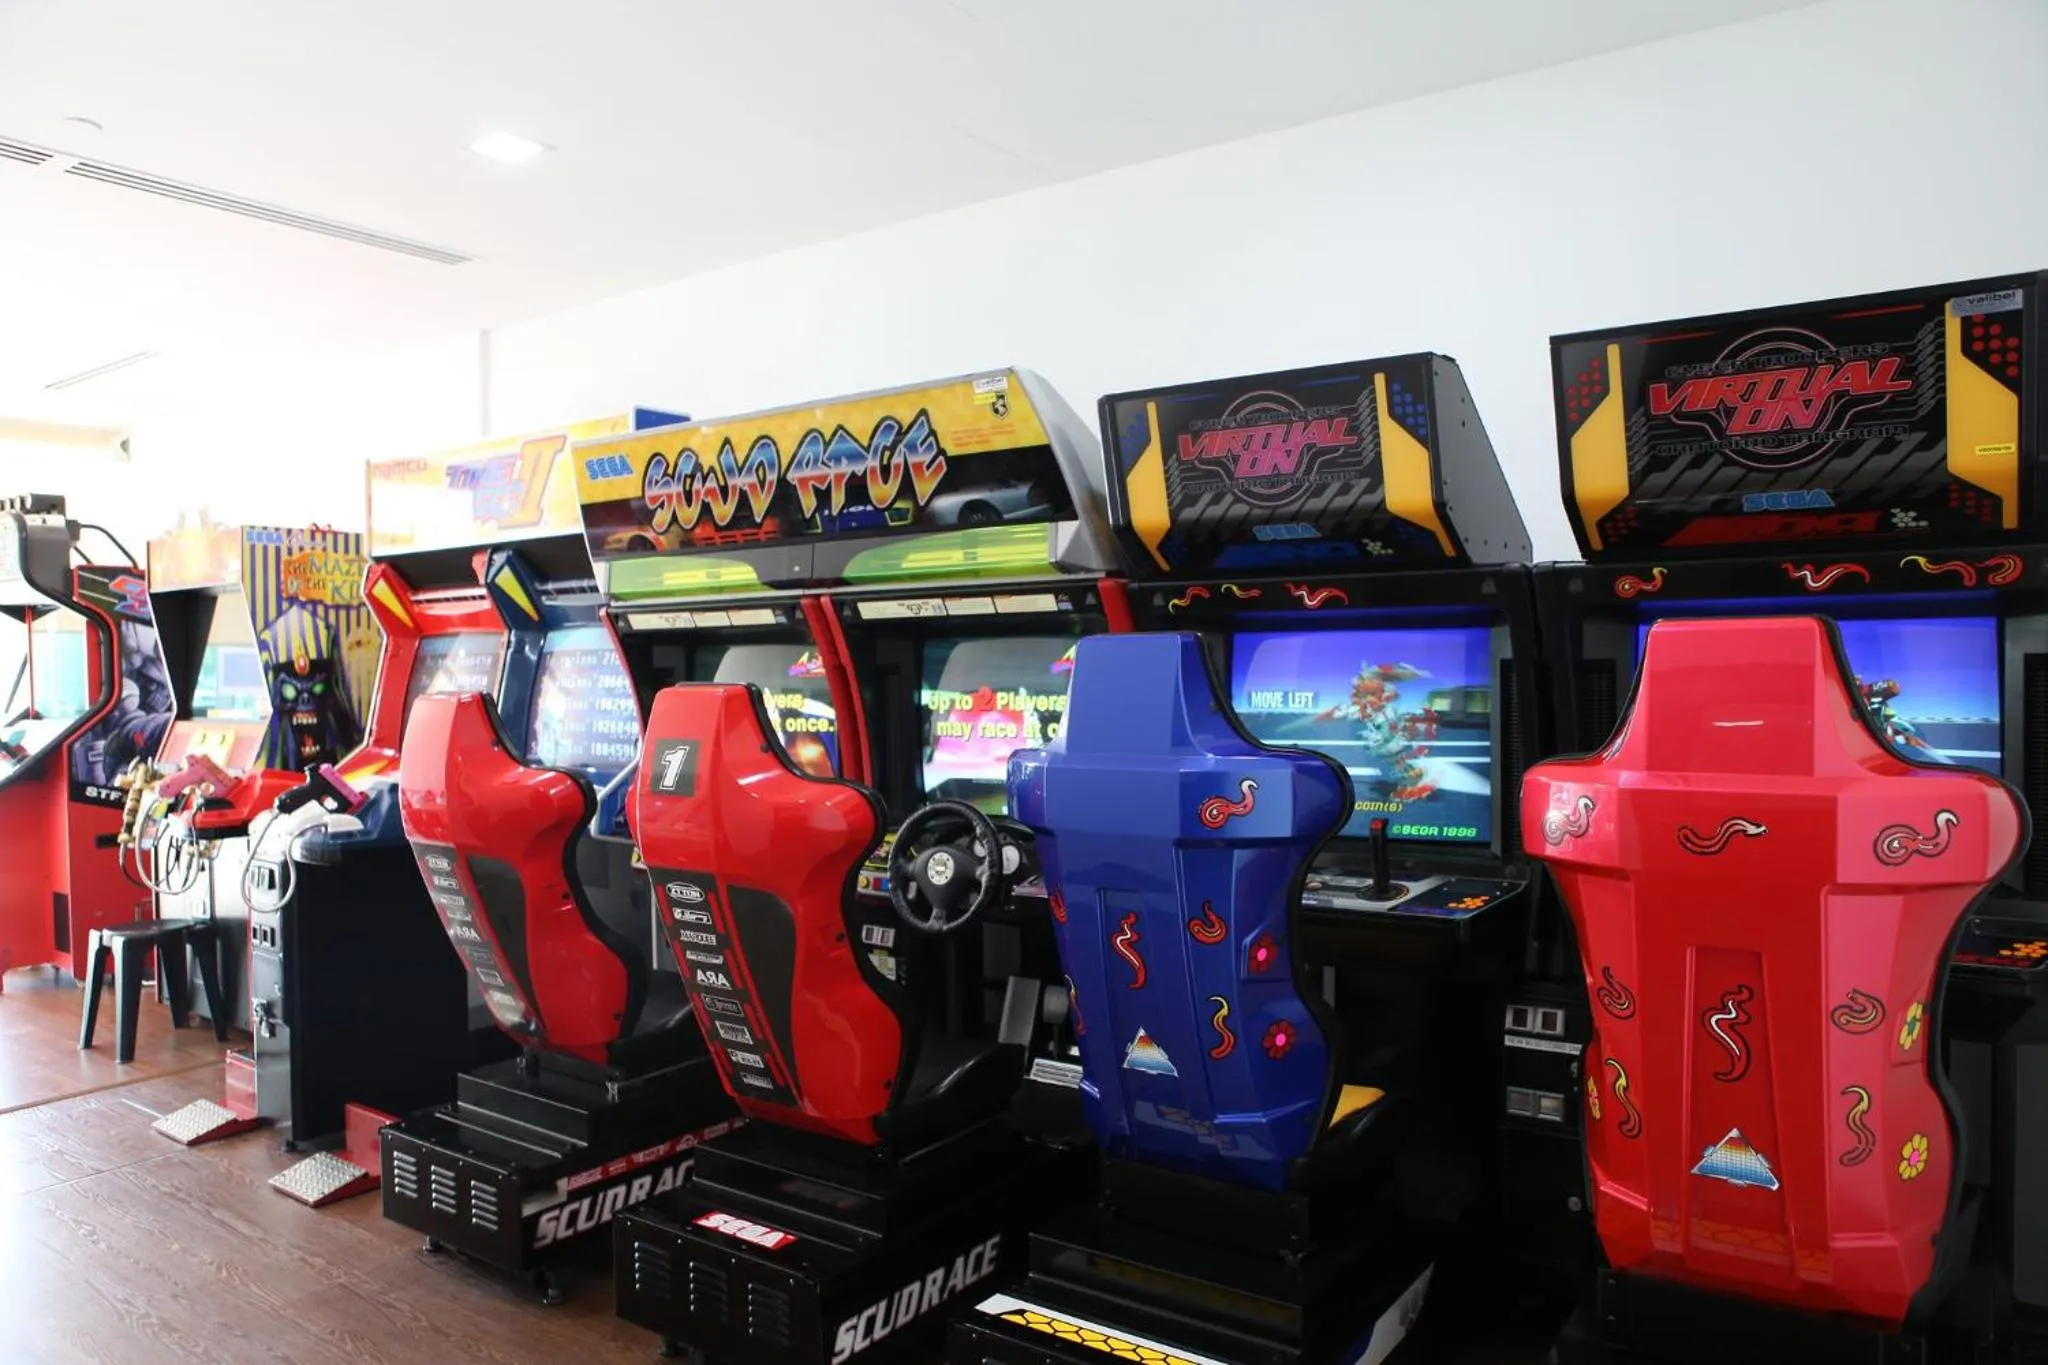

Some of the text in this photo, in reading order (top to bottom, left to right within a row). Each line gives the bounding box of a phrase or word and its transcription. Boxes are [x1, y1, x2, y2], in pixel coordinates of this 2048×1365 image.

[1649, 357, 1913, 416] VIRTUAL
[1726, 395, 1833, 434] ON
[1178, 417, 1358, 461] VIRTUAL
[585, 453, 634, 481] SEGA
[1234, 447, 1302, 479] ON
[1742, 488, 1836, 512] SEGA
[955, 692, 973, 711] to
[1251, 691, 1314, 708] MOVE LEFT
[785, 718, 834, 732] once.
[936, 721, 972, 741] may
[980, 723, 1017, 739] race
[660, 745, 688, 790] 1
[533, 1159, 695, 1249] SCUDRAC
[699, 1213, 787, 1249] SEGA
